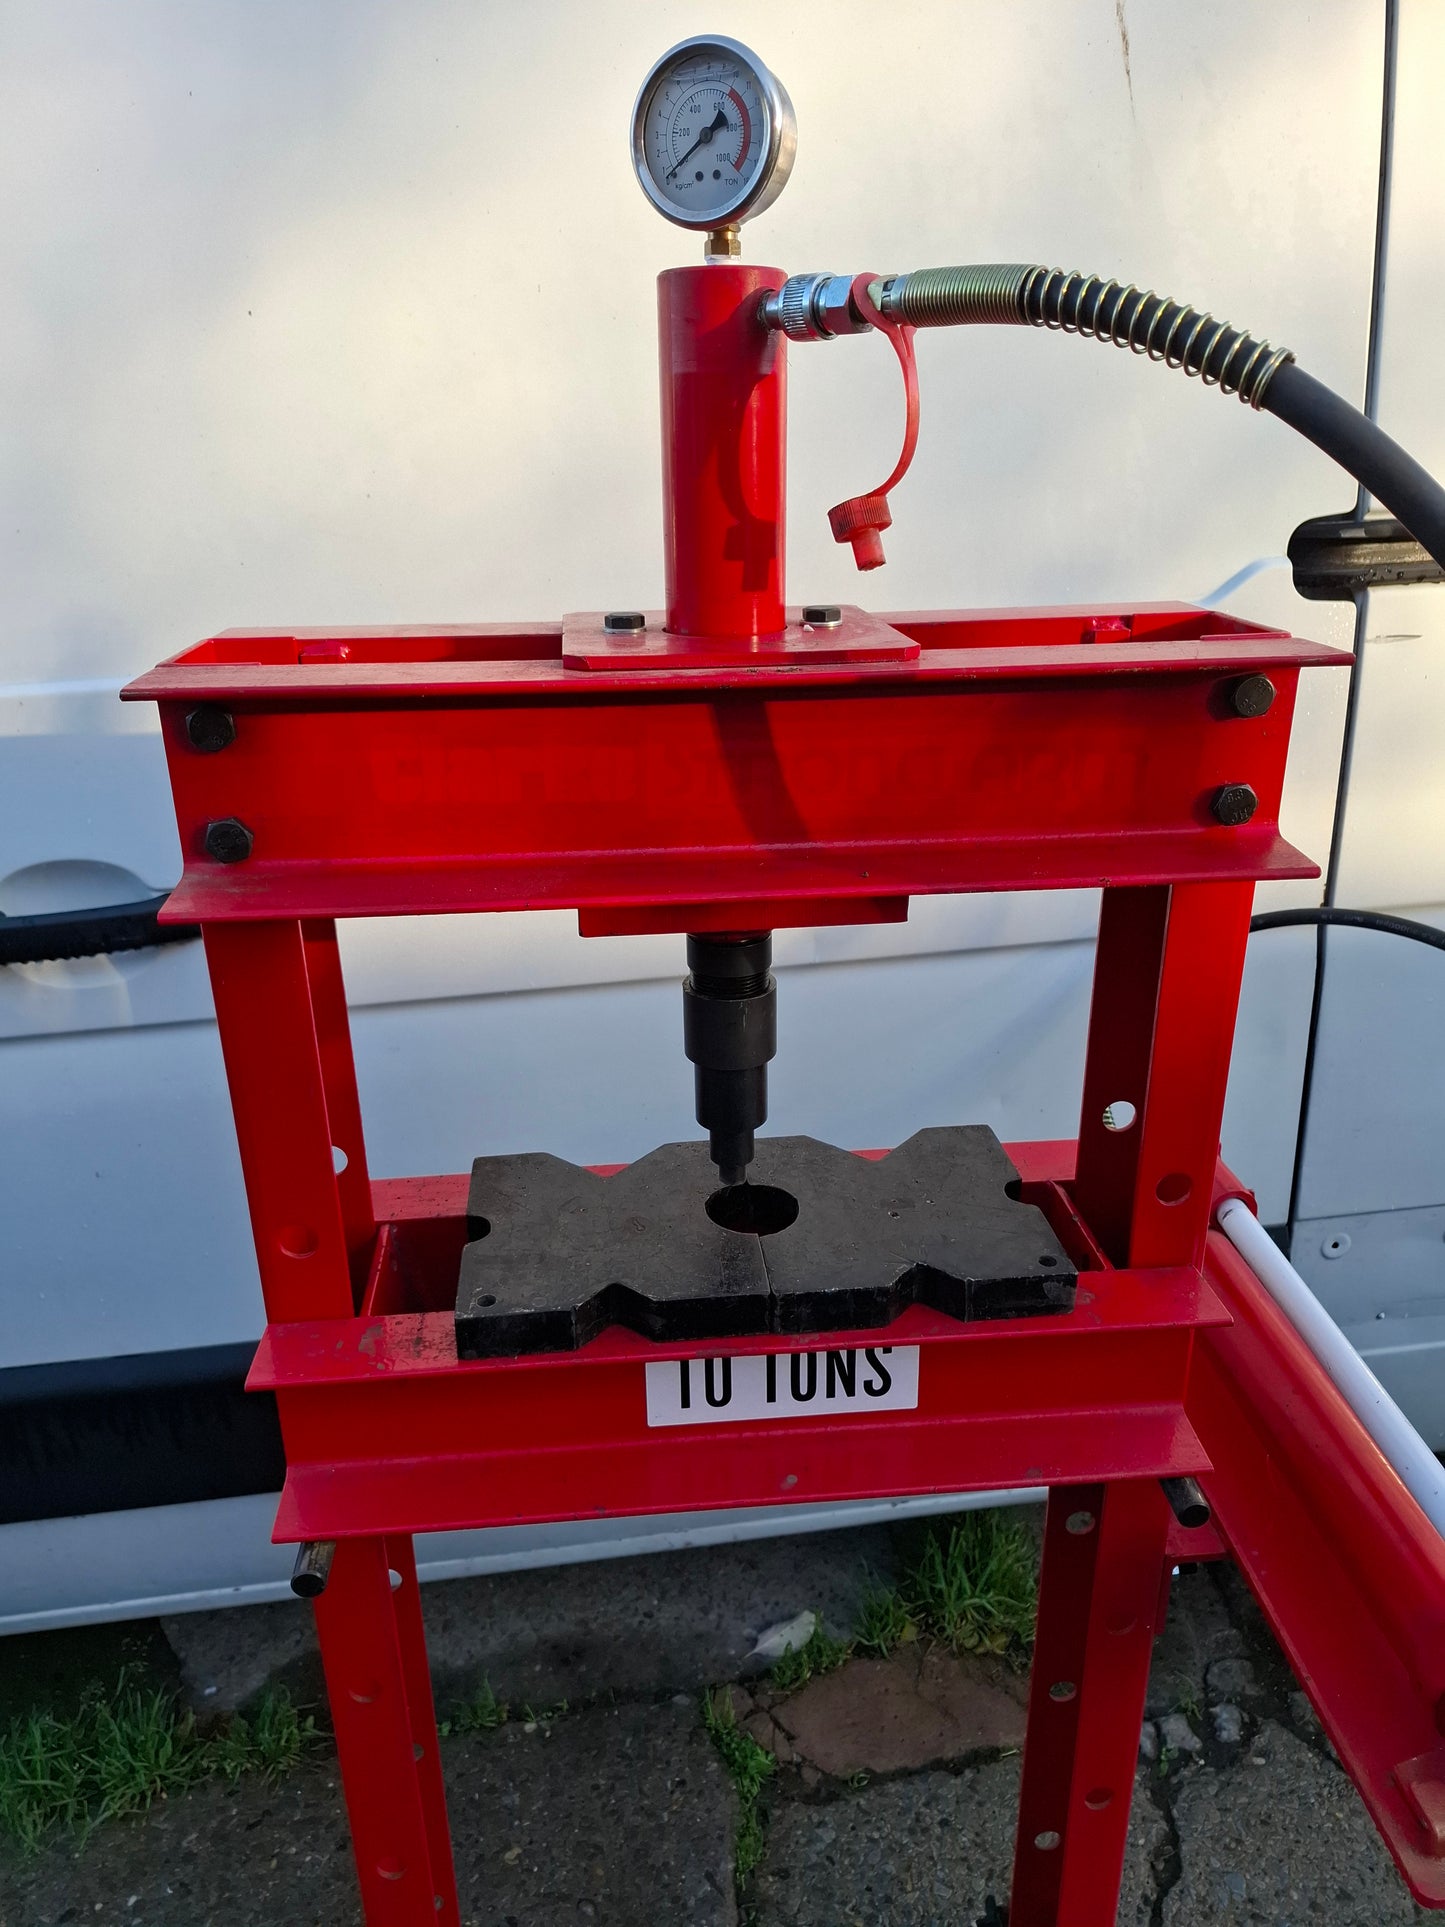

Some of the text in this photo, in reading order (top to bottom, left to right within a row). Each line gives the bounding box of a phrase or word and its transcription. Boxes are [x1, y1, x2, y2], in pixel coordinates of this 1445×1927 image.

[689, 104, 701, 113] 400
[713, 101, 725, 111] 600
[679, 127, 690, 137] 200
[716, 152, 731, 162] 1000
[724, 178, 738, 186] TON
[679, 1346, 893, 1409] 10 TONS
